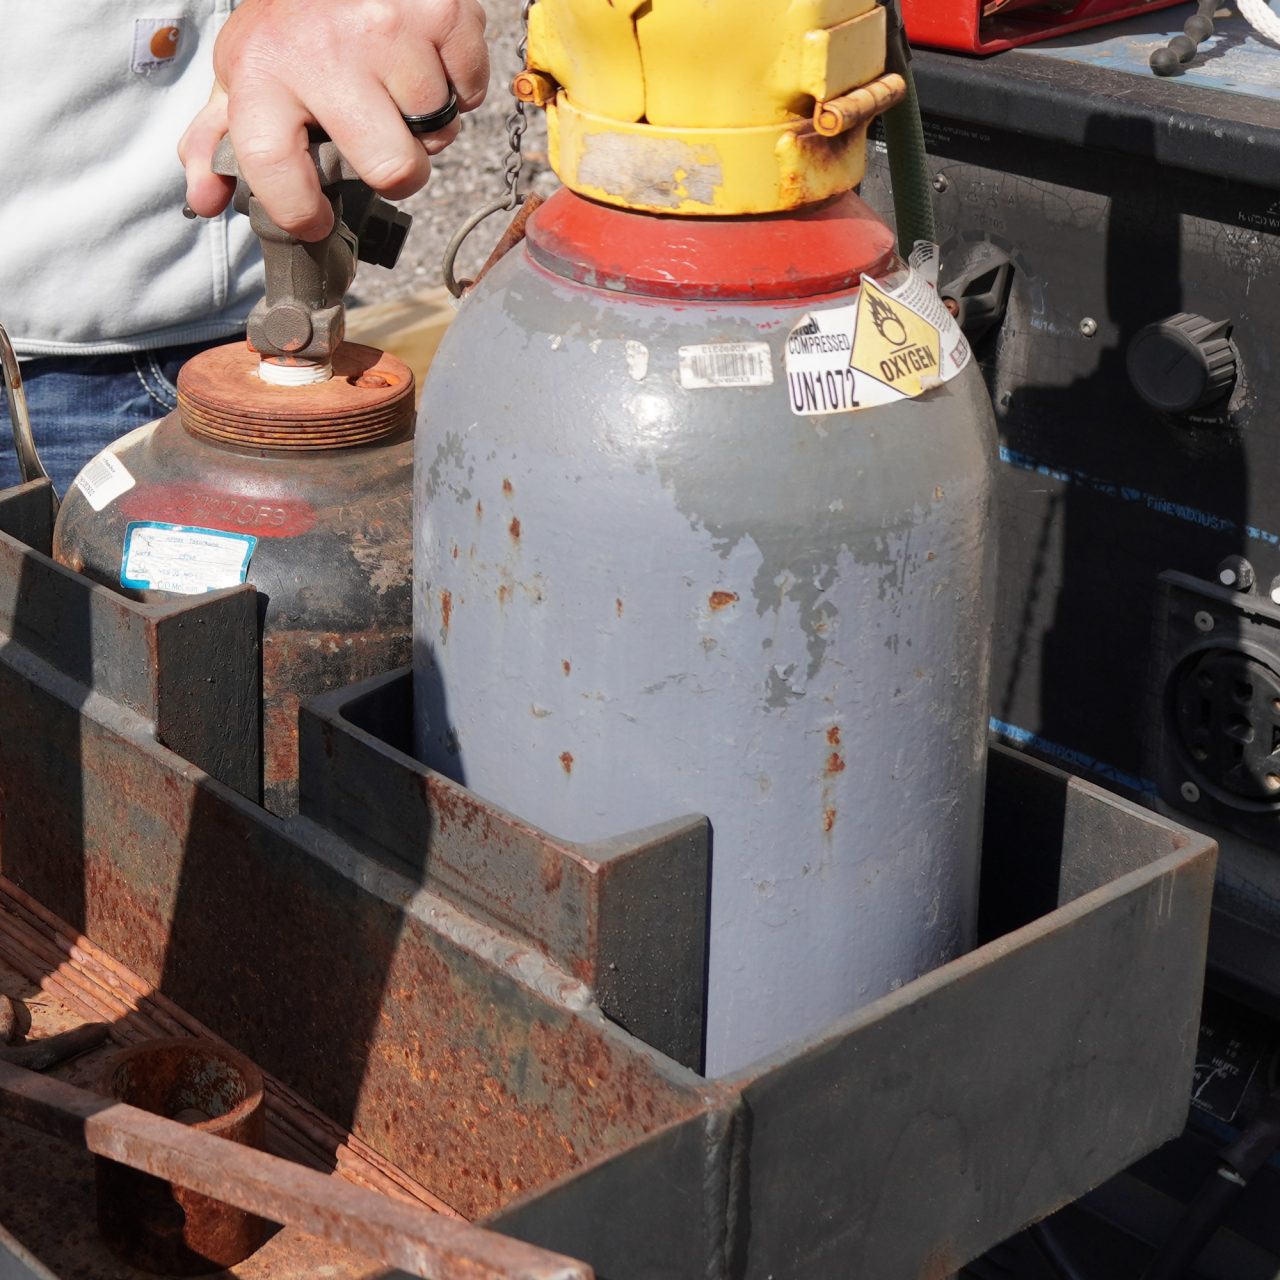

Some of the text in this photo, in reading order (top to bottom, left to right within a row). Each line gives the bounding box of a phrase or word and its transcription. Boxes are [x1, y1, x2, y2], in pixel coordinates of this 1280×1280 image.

[788, 334, 850, 355] COMPRESSED
[879, 344, 937, 383] OXYGEN
[789, 369, 861, 412] UN1072
